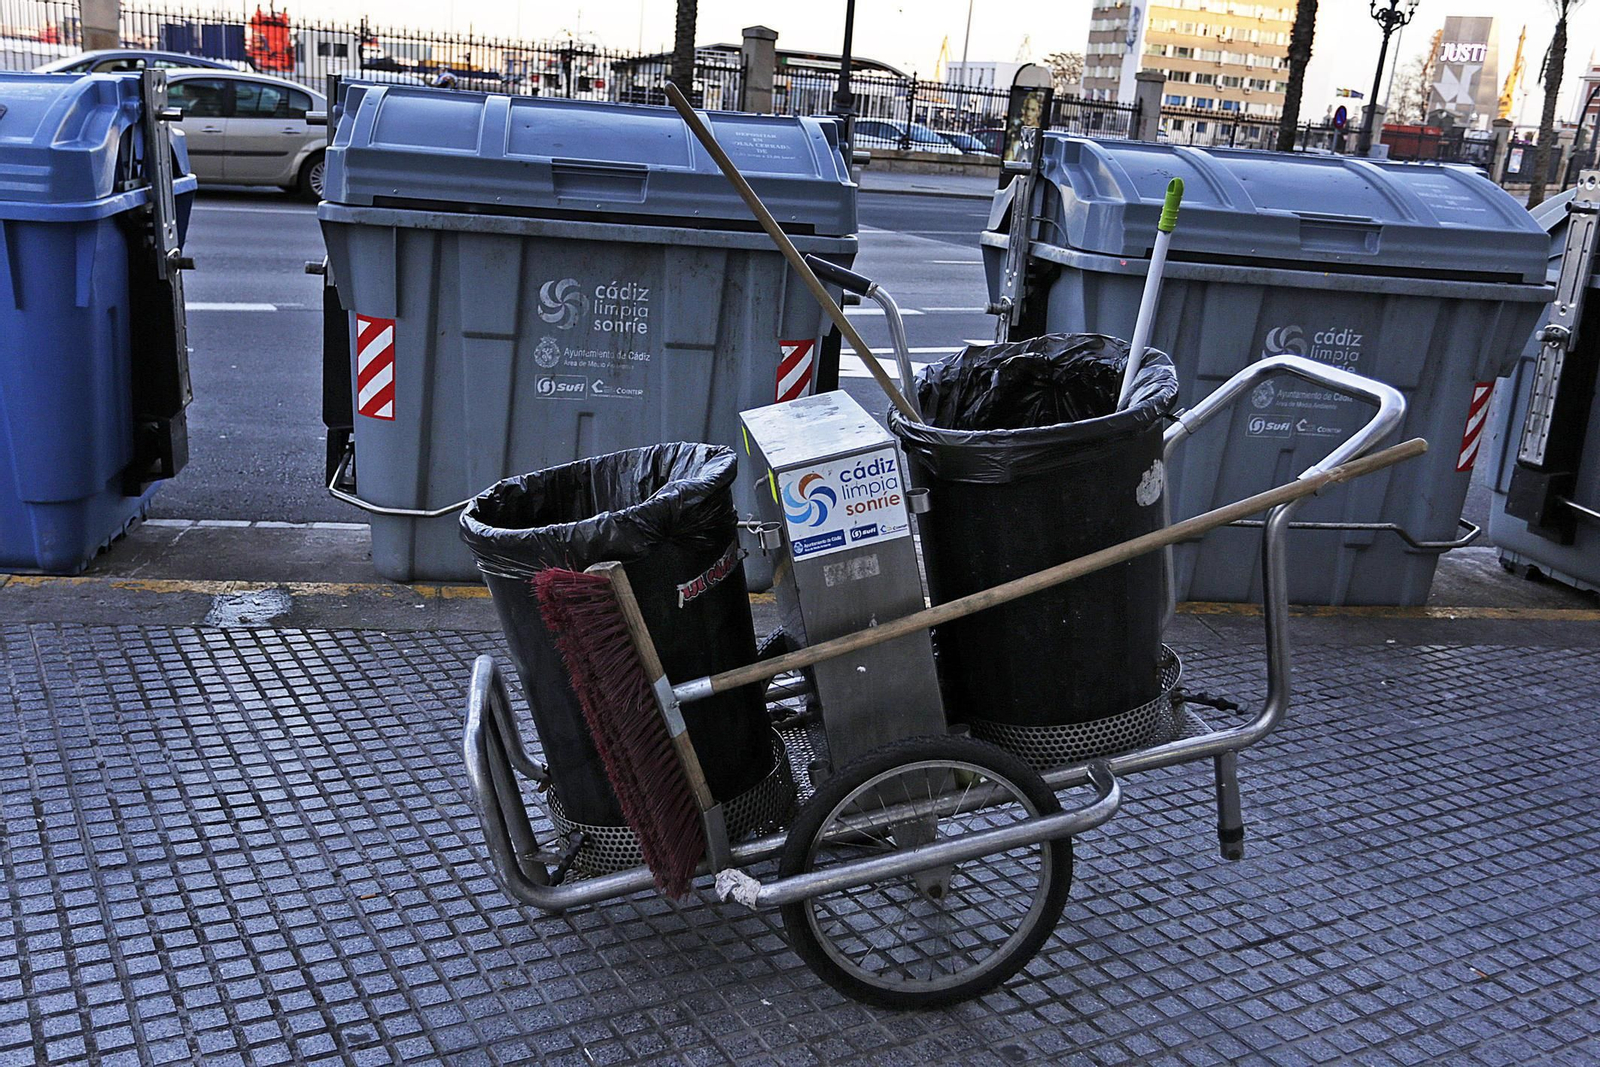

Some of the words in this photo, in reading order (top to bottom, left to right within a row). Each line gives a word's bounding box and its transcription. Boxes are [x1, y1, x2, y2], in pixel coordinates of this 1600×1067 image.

[595, 280, 650, 302] cádiz
[594, 299, 649, 319] limpia
[593, 317, 648, 334] sonríe
[1314, 327, 1363, 347] cádiz
[628, 351, 651, 361] Cádiz
[1310, 344, 1360, 363] limpia
[839, 457, 896, 483] cádiz
[841, 476, 898, 500] limpia
[845, 491, 901, 516] sonríe
